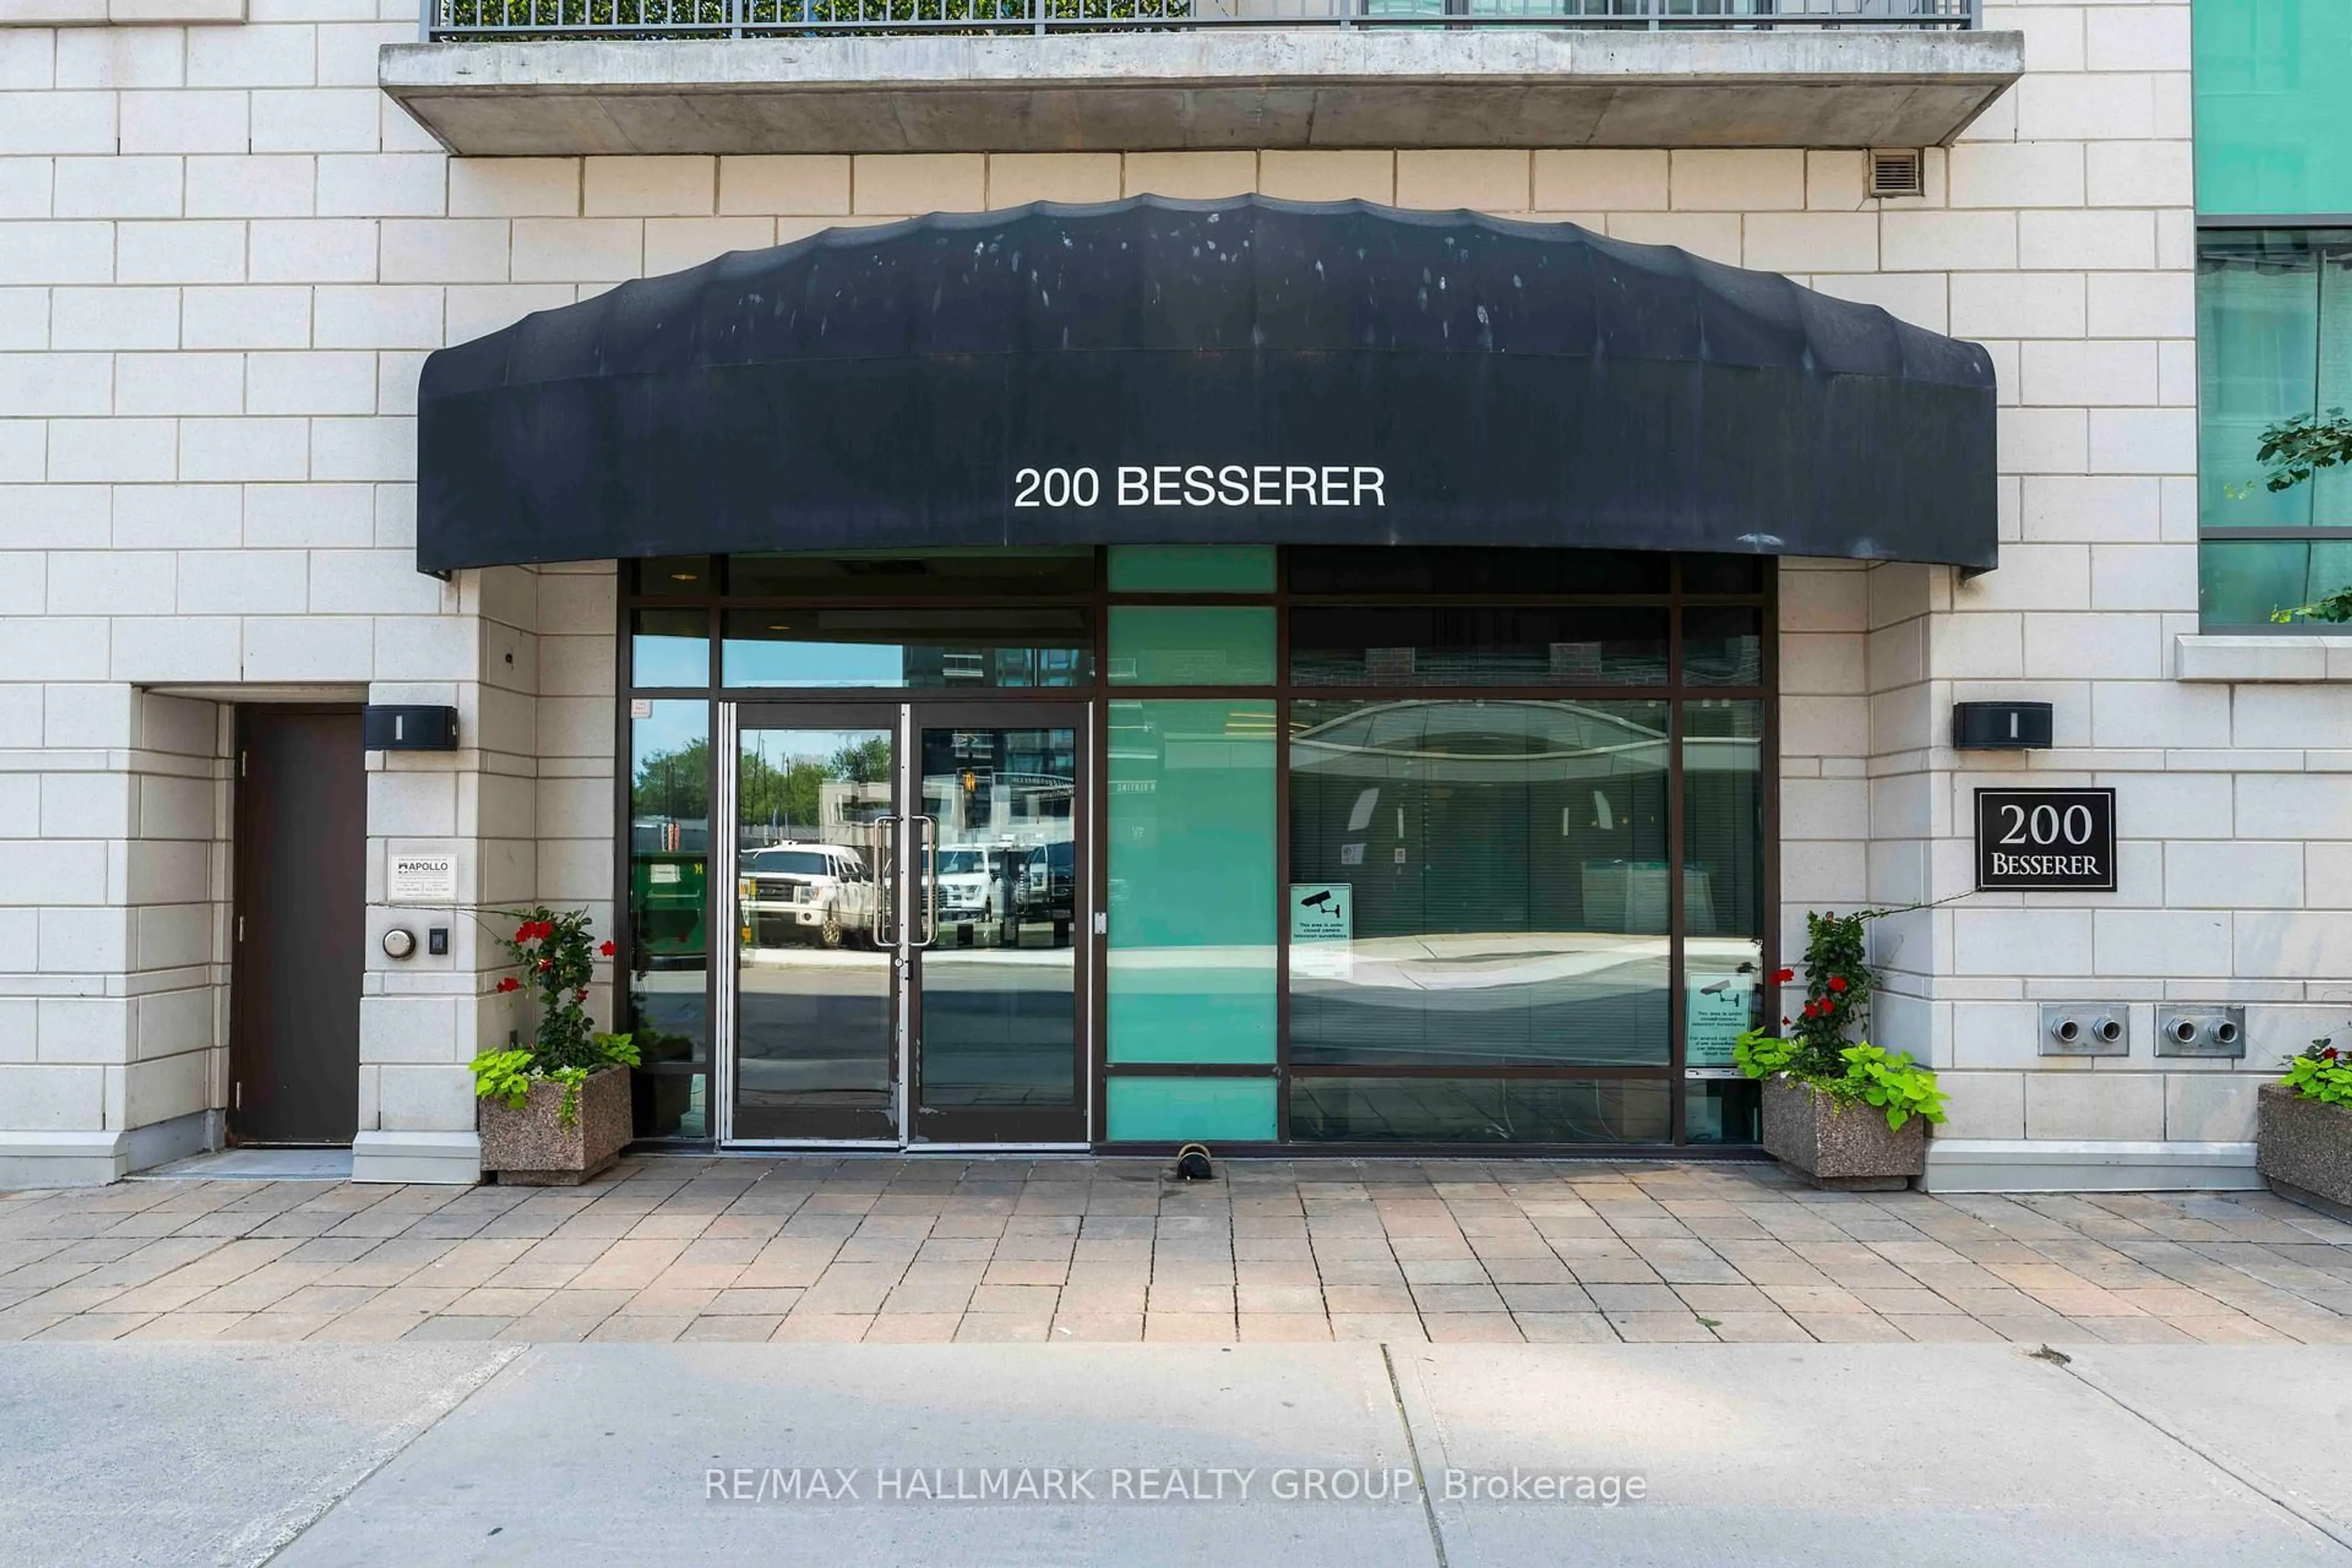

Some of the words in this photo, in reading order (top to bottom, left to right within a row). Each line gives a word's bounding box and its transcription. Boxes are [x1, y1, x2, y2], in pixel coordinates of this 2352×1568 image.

[1014, 467, 1099, 507] 200
[1117, 466, 1385, 507] BESSERER
[1999, 804, 2093, 845] 200
[409, 862, 448, 870] APOLLO
[1991, 852, 2102, 875] BESSERER
